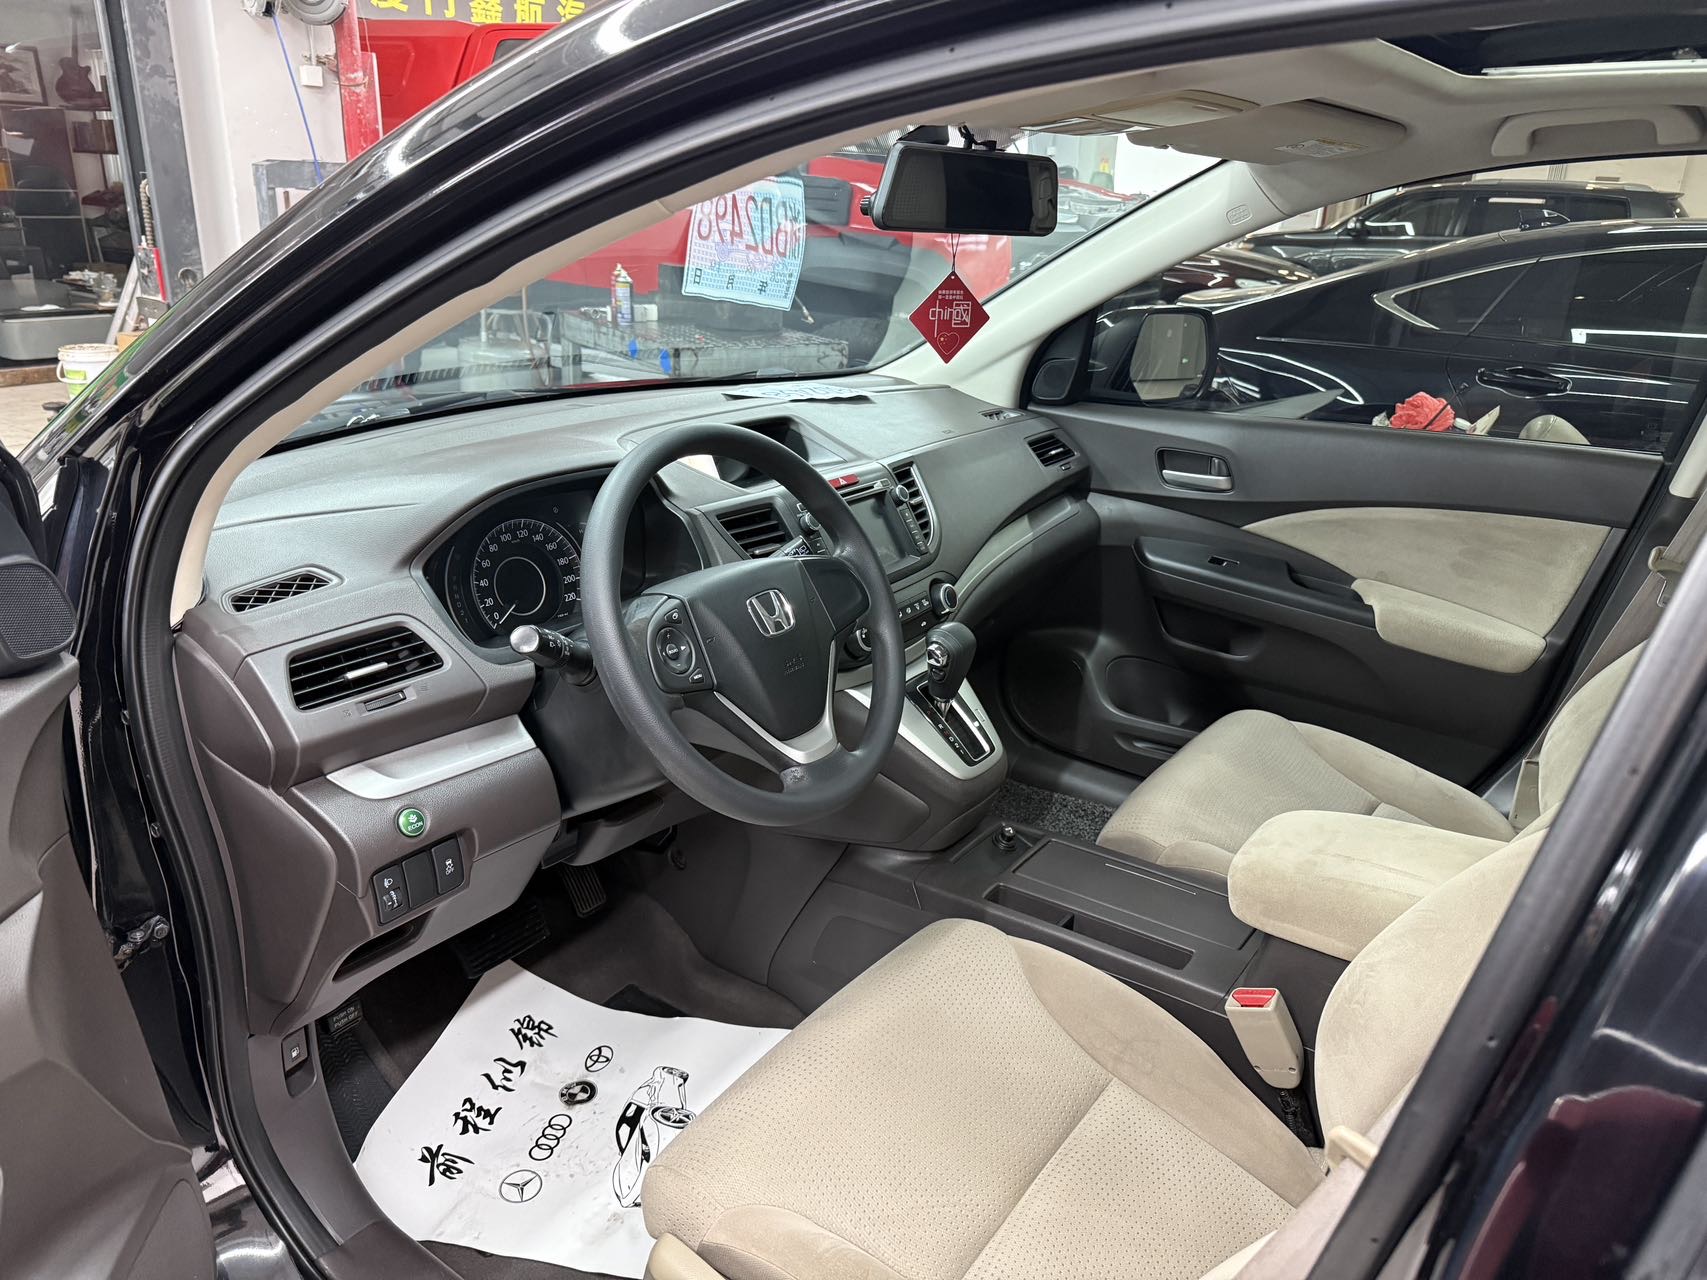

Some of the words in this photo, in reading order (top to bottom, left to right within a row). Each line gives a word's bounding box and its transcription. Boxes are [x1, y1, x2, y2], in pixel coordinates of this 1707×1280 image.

[500, 532, 512, 542] 100
[516, 529, 529, 538] 120
[532, 533, 544, 542] 140
[488, 543, 498, 552] 80
[545, 541, 558, 551] 160
[481, 559, 491, 568] 60
[557, 556, 569, 566] 180
[480, 578, 489, 587] 40
[563, 574, 576, 584] 200
[484, 597, 494, 607] 20
[564, 592, 577, 602] 220
[493, 611, 500, 620] 0
[408, 821, 424, 831] ECON
[332, 1011, 347, 1023] PUSH
[334, 1015, 348, 1028] PUSH
[348, 1010, 359, 1020] OFF
